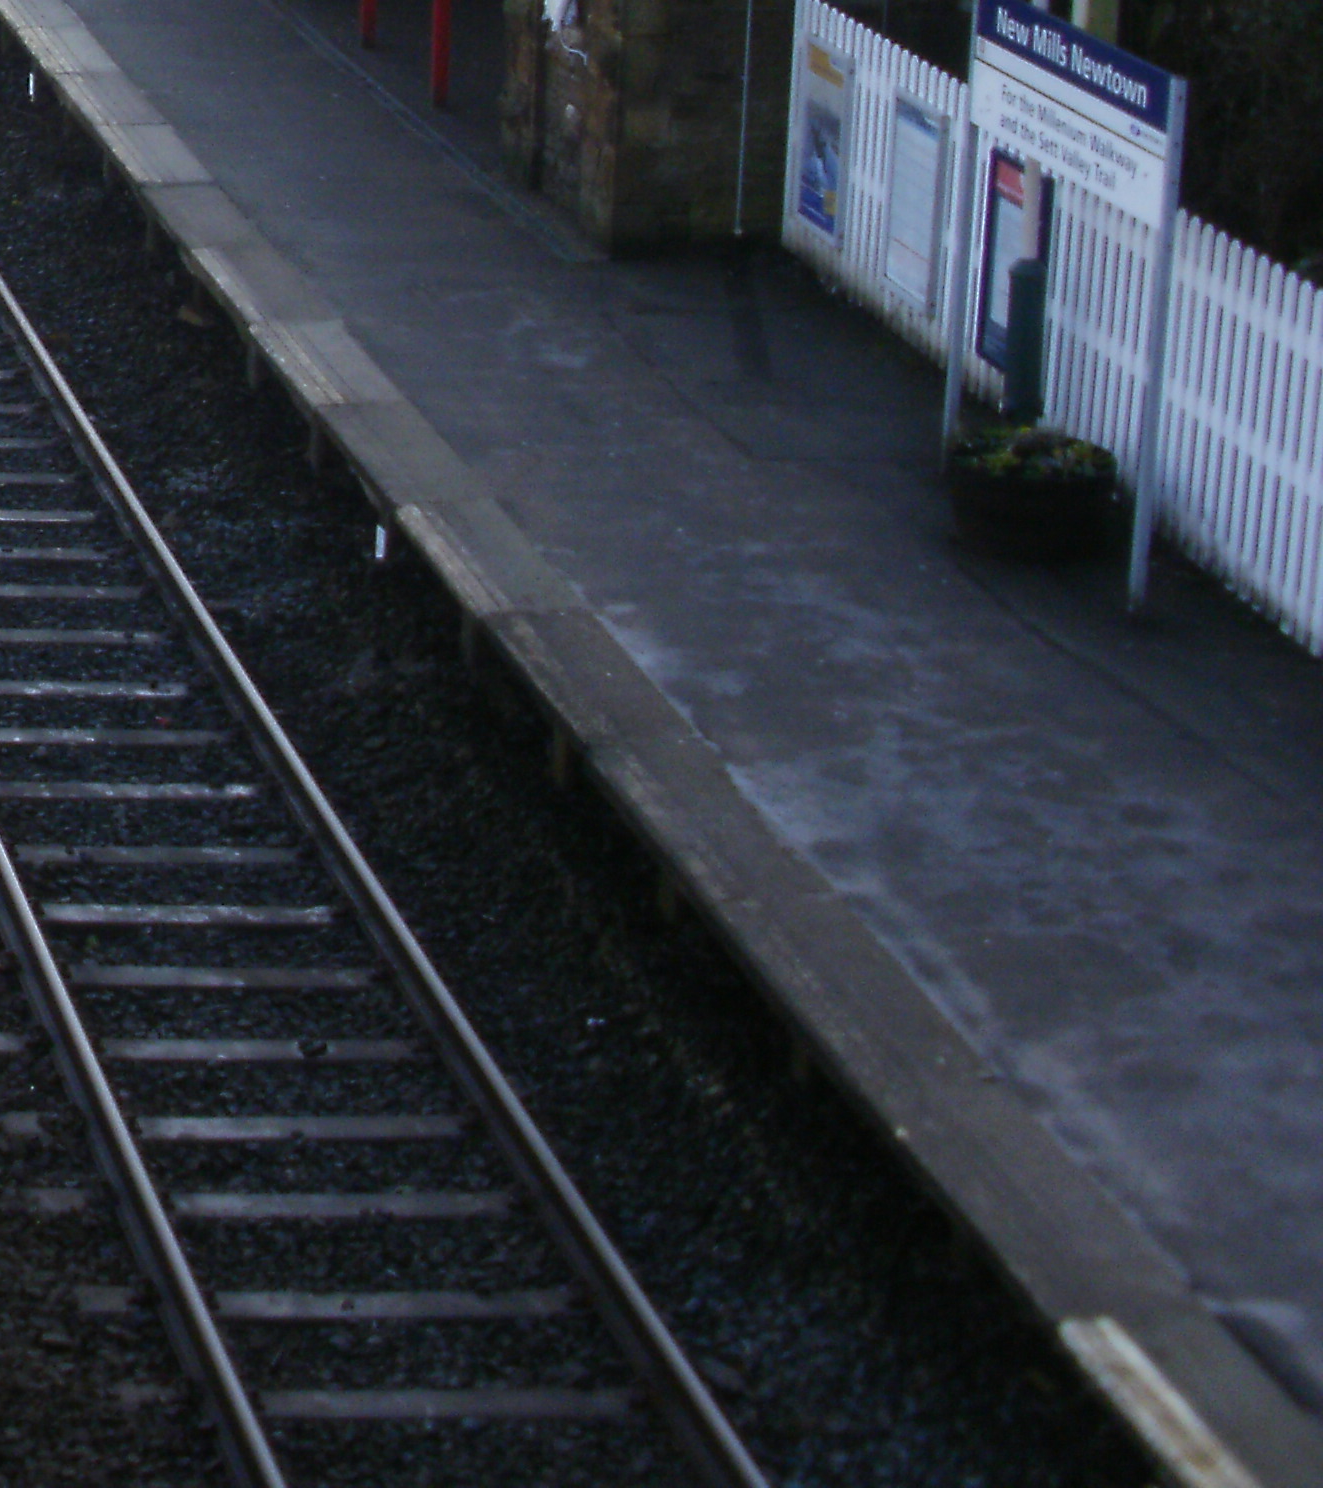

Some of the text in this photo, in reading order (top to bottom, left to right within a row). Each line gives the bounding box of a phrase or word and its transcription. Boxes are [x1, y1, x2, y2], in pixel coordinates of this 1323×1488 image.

[995, 6, 1149, 109] New Mills Newtown
[1001, 83, 1017, 107] For
[1019, 95, 1035, 118] the
[999, 113, 1018, 135] and
[1019, 123, 1036, 145] the
